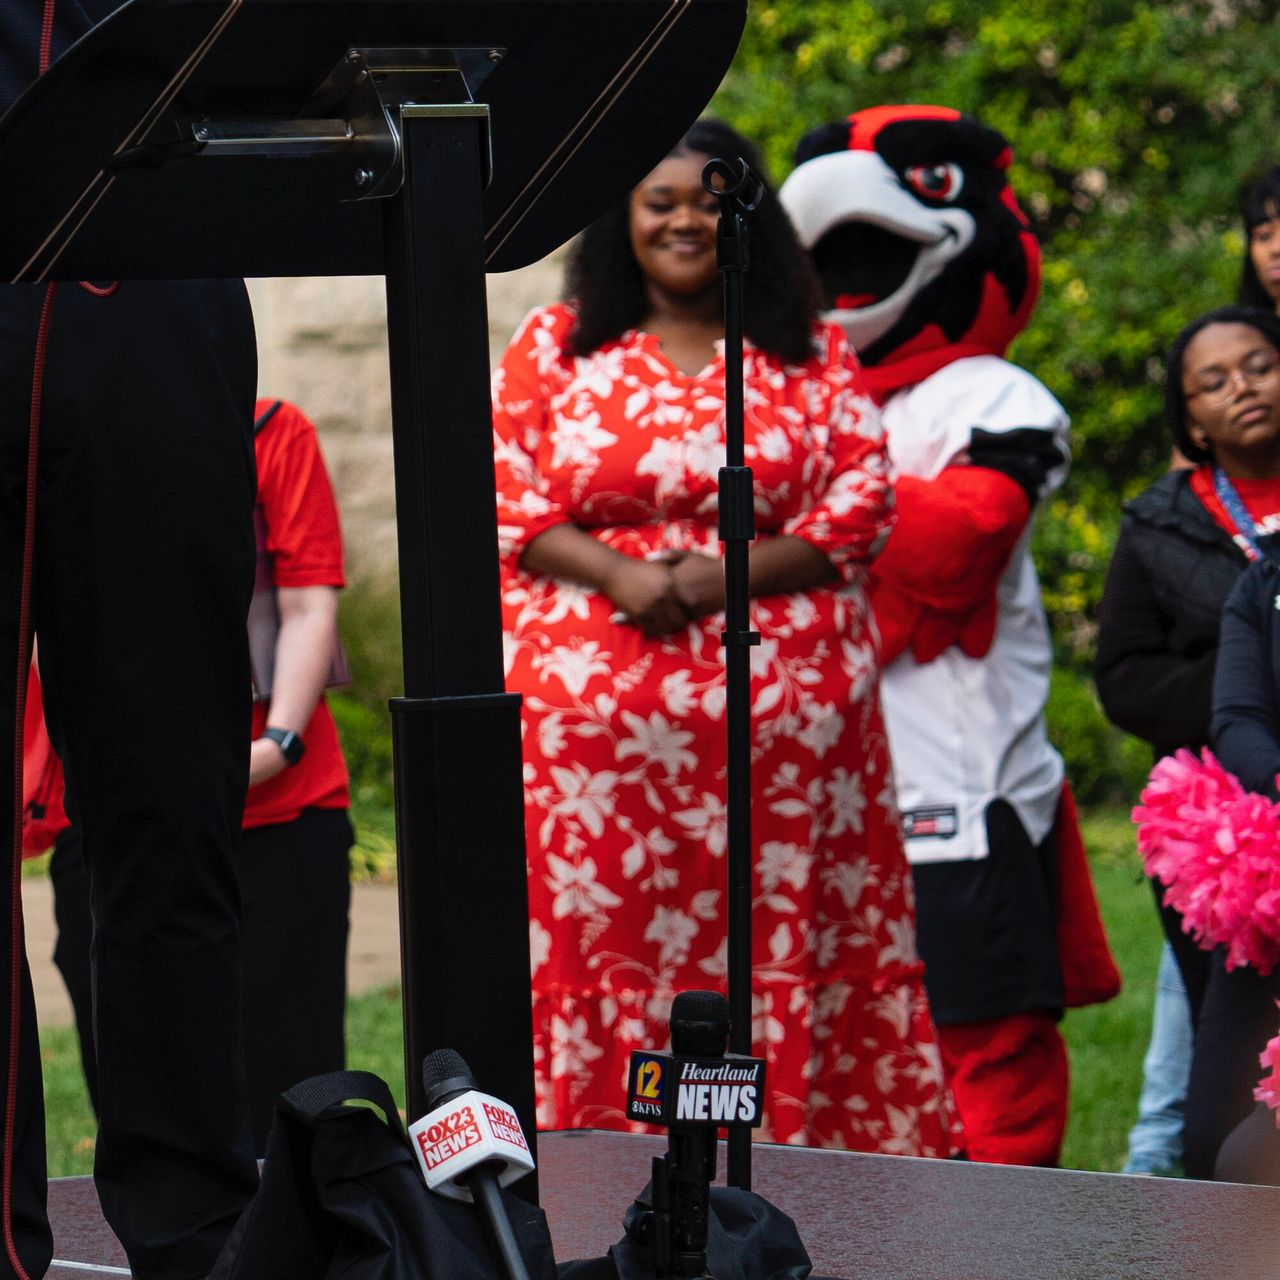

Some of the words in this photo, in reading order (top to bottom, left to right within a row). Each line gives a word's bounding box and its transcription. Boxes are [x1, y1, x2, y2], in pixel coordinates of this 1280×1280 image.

[636, 1061, 661, 1098] 12
[680, 1063, 759, 1080] Heartland
[639, 1102, 661, 1116] KFVS
[677, 1084, 756, 1121] NEWS
[417, 1106, 475, 1151] FOX23
[425, 1125, 480, 1167] NEWS
[491, 1121, 526, 1148] NEWS
